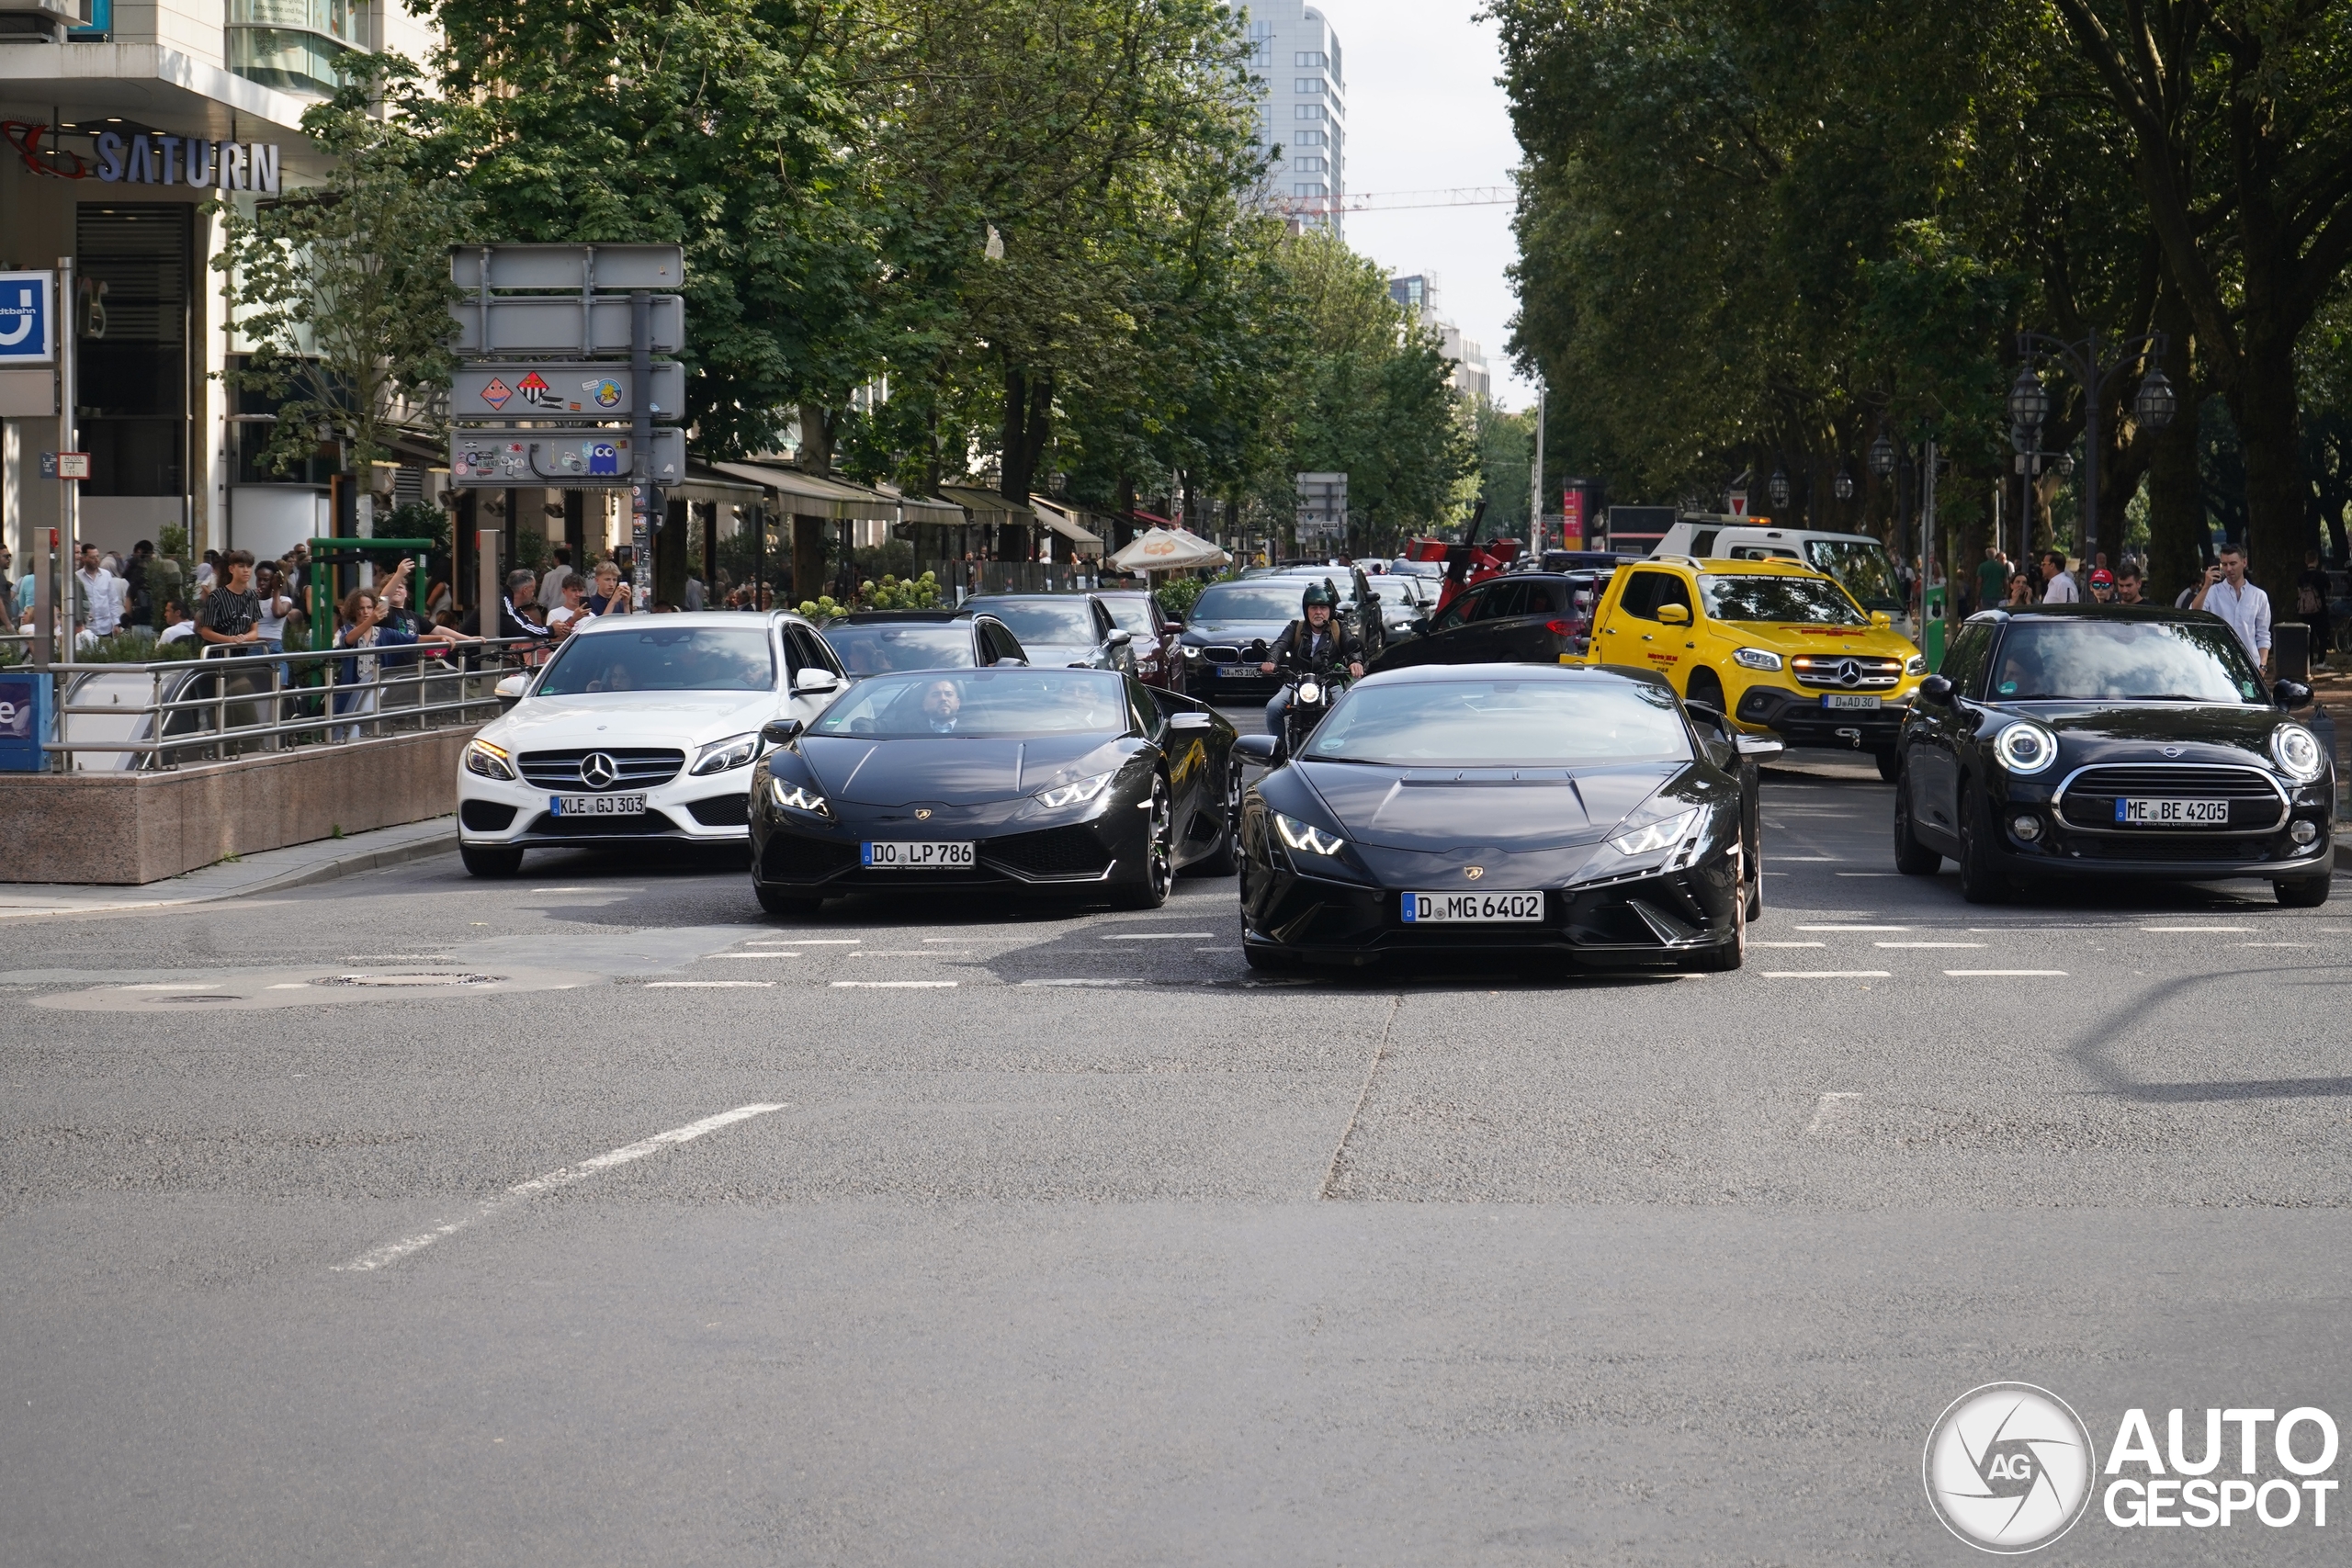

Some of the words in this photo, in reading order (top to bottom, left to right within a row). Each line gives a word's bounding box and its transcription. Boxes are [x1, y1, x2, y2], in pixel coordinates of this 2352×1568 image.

[95, 131, 279, 192] SATURN
[1221, 668, 1232, 676] HA
[1234, 668, 1244, 677] MS
[1835, 696, 1842, 707] D
[1847, 697, 1860, 707] AD
[1861, 697, 1873, 707] 30
[560, 798, 586, 814] KLE
[596, 797, 614, 814] GJ
[617, 797, 643, 813] 303
[2127, 801, 2148, 819] ME
[2161, 802, 2182, 820] BE
[2187, 802, 2226, 820] 4205
[873, 844, 897, 863] DO
[910, 844, 933, 863] LP
[937, 844, 972, 863] 786
[1418, 897, 1432, 919] D
[1448, 897, 1477, 919] MG
[1482, 896, 1539, 918] 6402
